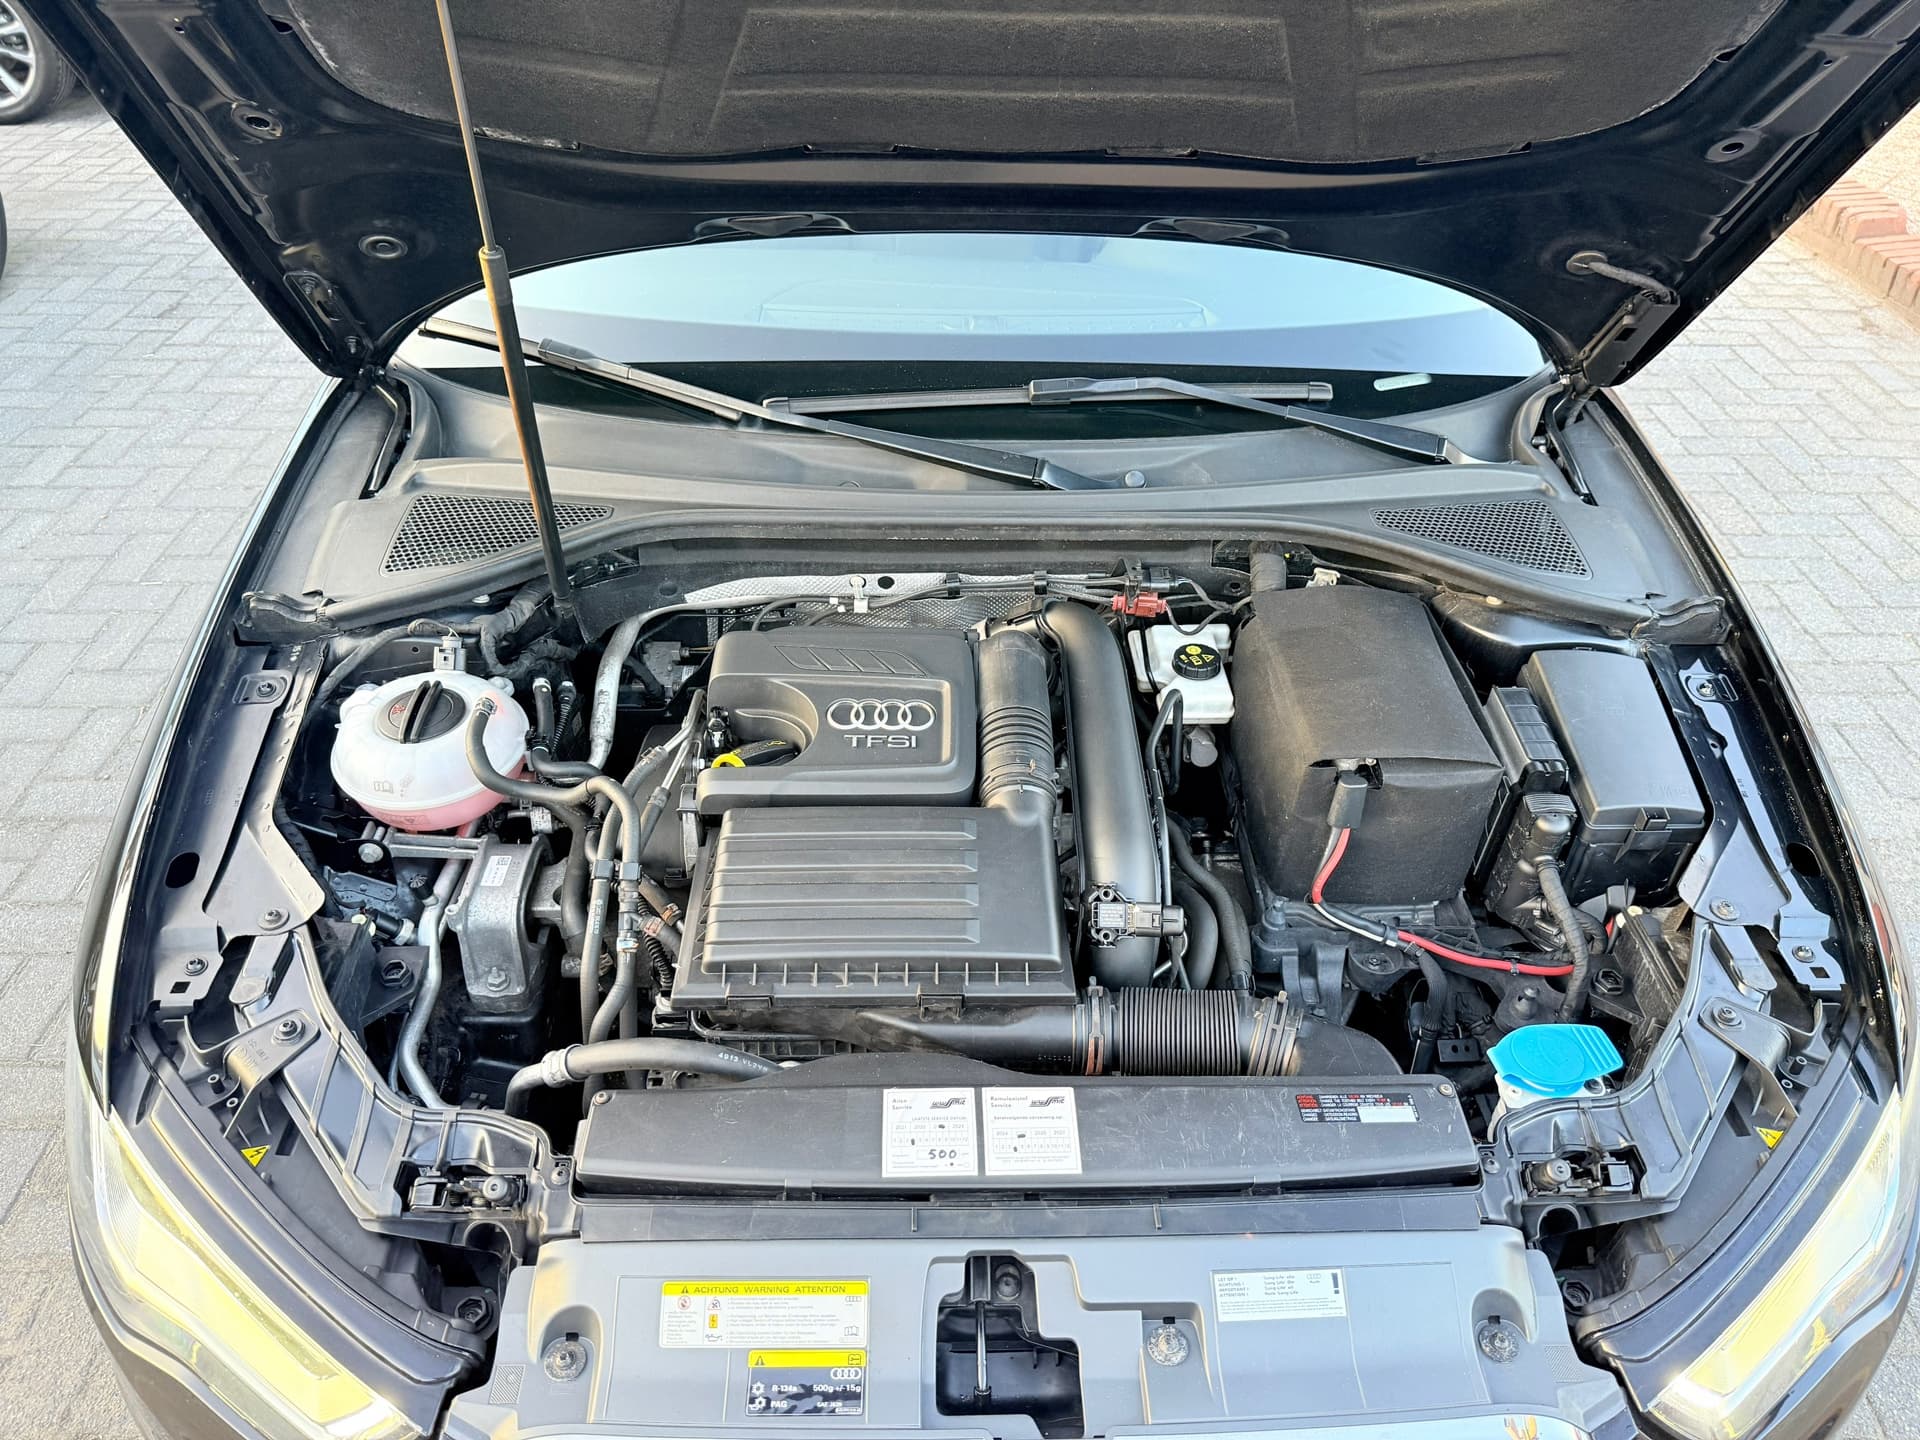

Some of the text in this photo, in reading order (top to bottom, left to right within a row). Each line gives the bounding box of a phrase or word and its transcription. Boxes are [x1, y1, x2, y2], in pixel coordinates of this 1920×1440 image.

[843, 734, 918, 748] TFSI
[928, 1149, 957, 1160] 500
[694, 1285, 846, 1294] ACHTUNG WARNING ATTENTION
[813, 1384, 833, 1392] 500g
